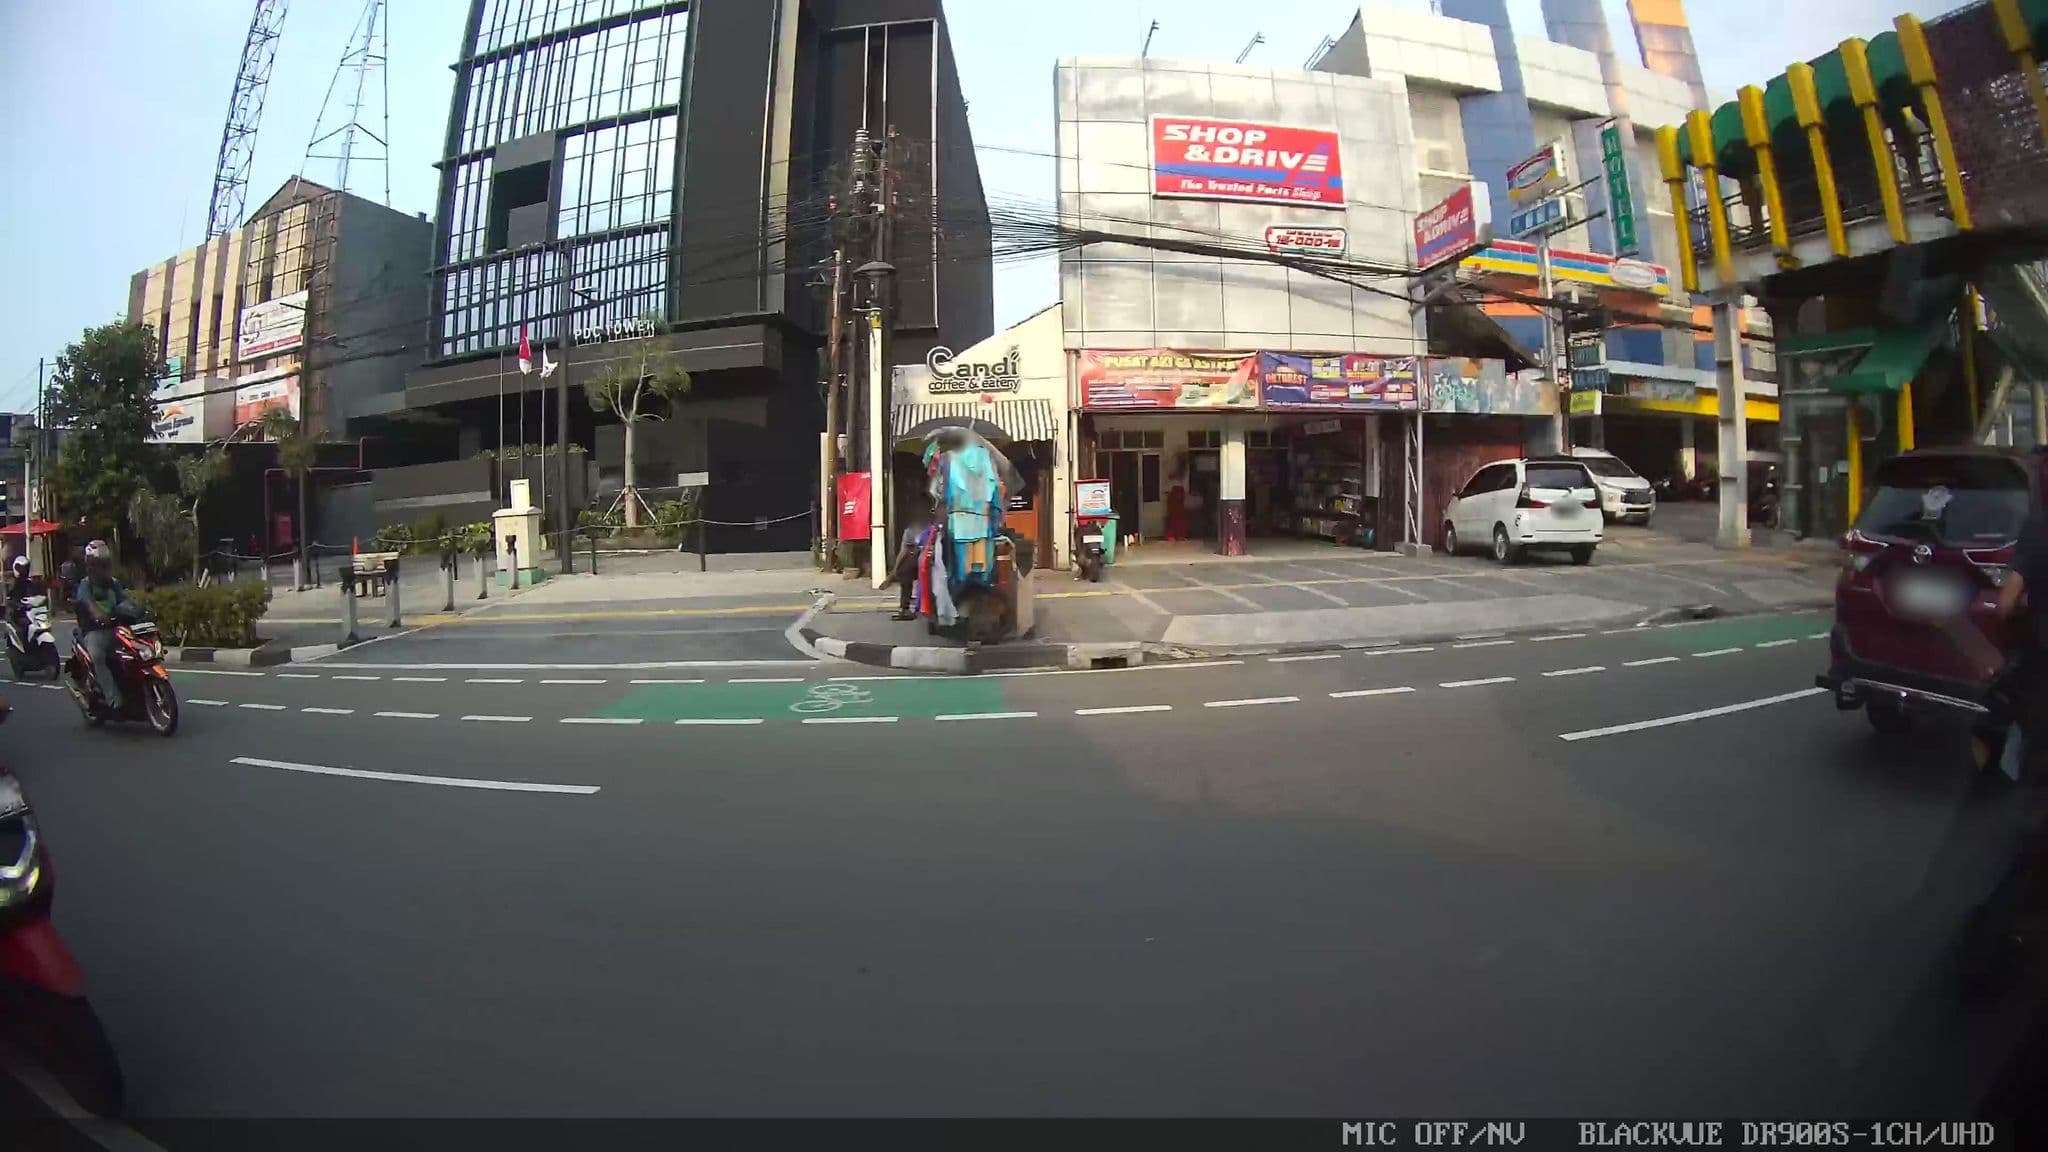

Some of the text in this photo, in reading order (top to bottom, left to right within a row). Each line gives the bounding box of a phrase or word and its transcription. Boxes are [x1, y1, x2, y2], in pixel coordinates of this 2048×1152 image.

[1162, 124, 1267, 145] SHOP
[1184, 144, 1329, 172] &DRIVE
[1181, 179, 1322, 200] The Trusted Parts Shop
[574, 319, 655, 340] PDC TOWER
[927, 346, 1020, 378] Candi
[928, 378, 1020, 393] coffee & eatery
